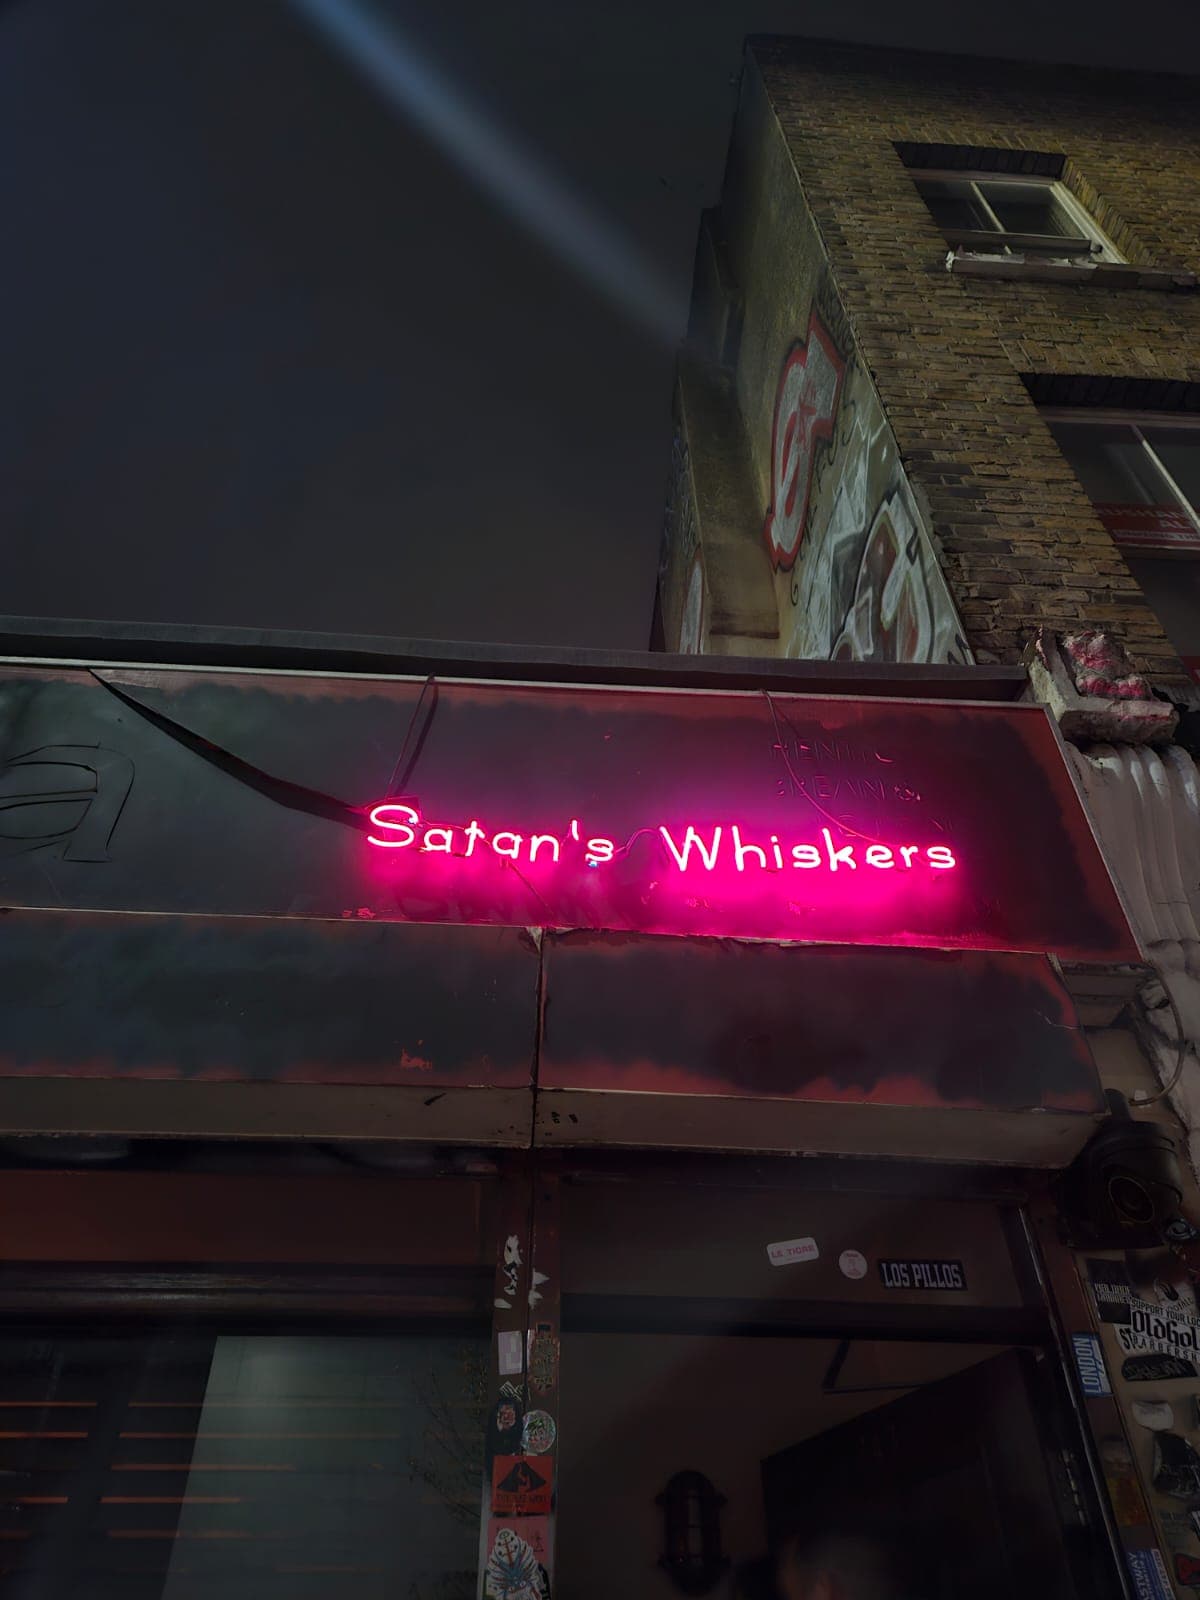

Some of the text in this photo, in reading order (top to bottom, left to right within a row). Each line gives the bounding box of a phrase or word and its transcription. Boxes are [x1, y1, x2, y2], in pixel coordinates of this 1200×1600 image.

[366, 802, 616, 865] Satan's
[658, 822, 958, 873] Whiskers
[881, 1262, 910, 1287] LOS
[910, 1263, 963, 1289] PILLOS
[1131, 1298, 1163, 1316] SUPPORT
[1165, 1309, 1186, 1324] YOUR
[1072, 1338, 1102, 1393] LONDON
